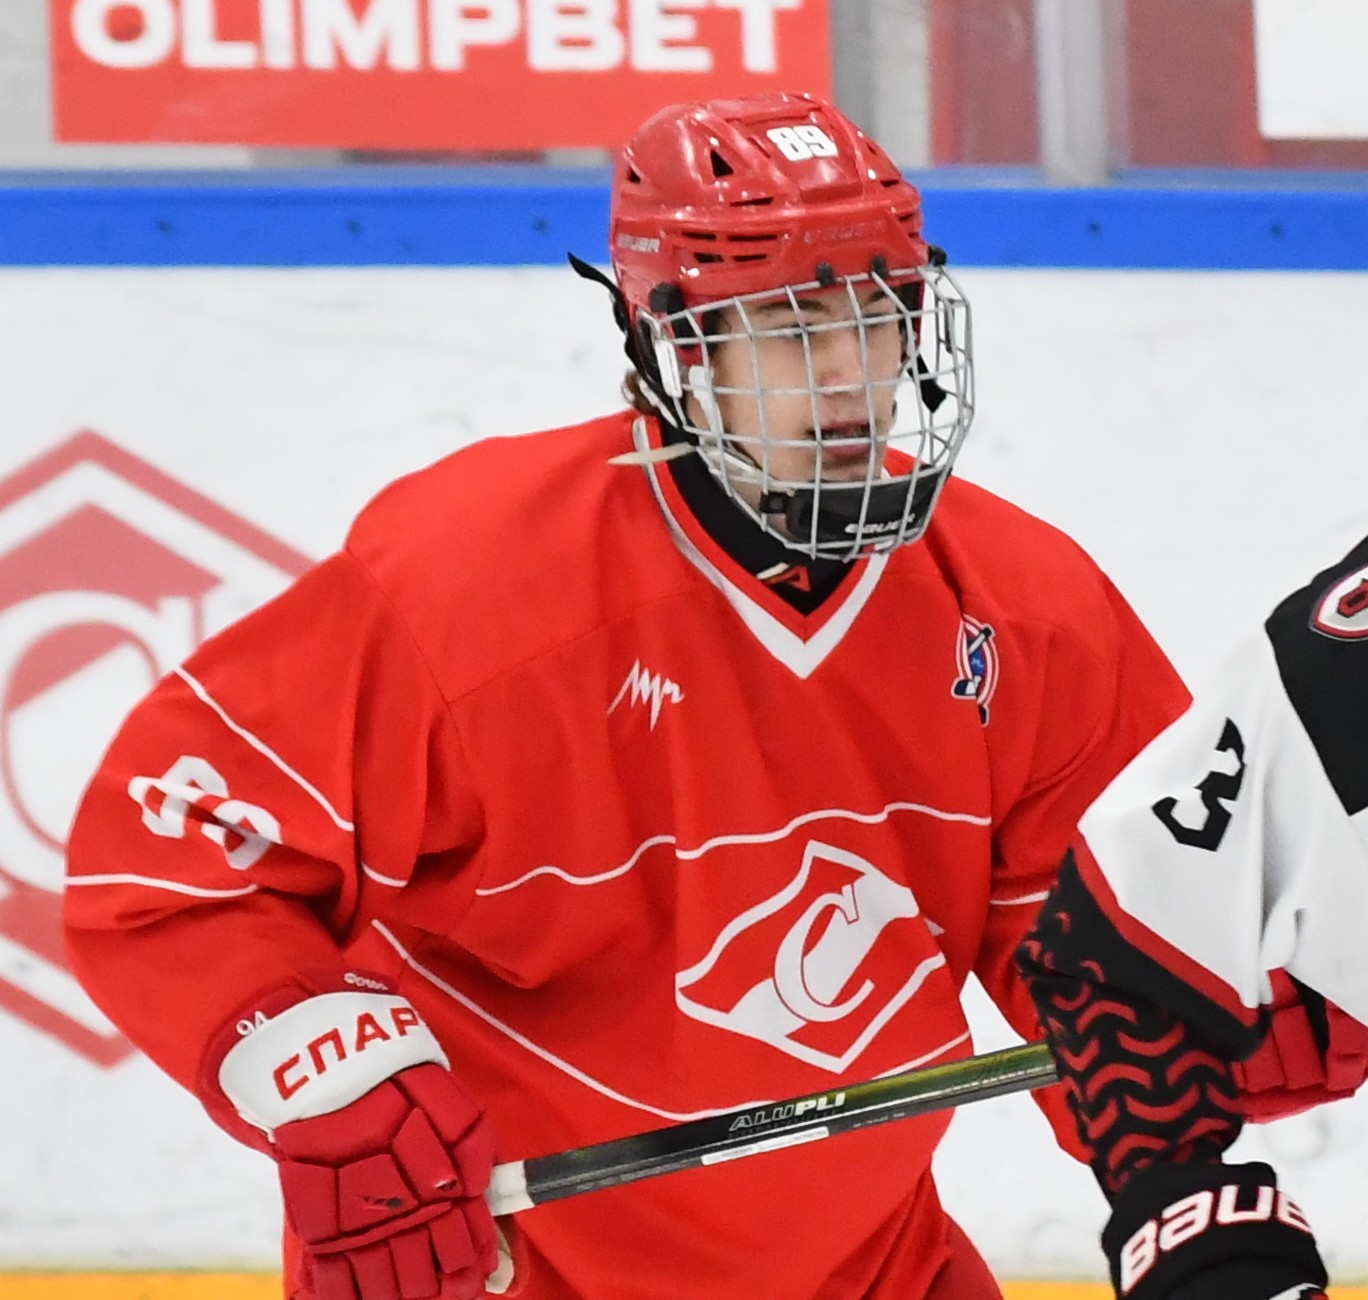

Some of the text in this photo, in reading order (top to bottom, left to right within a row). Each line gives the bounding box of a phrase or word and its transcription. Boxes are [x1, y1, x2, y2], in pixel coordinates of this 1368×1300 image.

[70, 0, 801, 73] OLIMPBET
[766, 125, 839, 162] 89
[1151, 716, 1248, 852] 3
